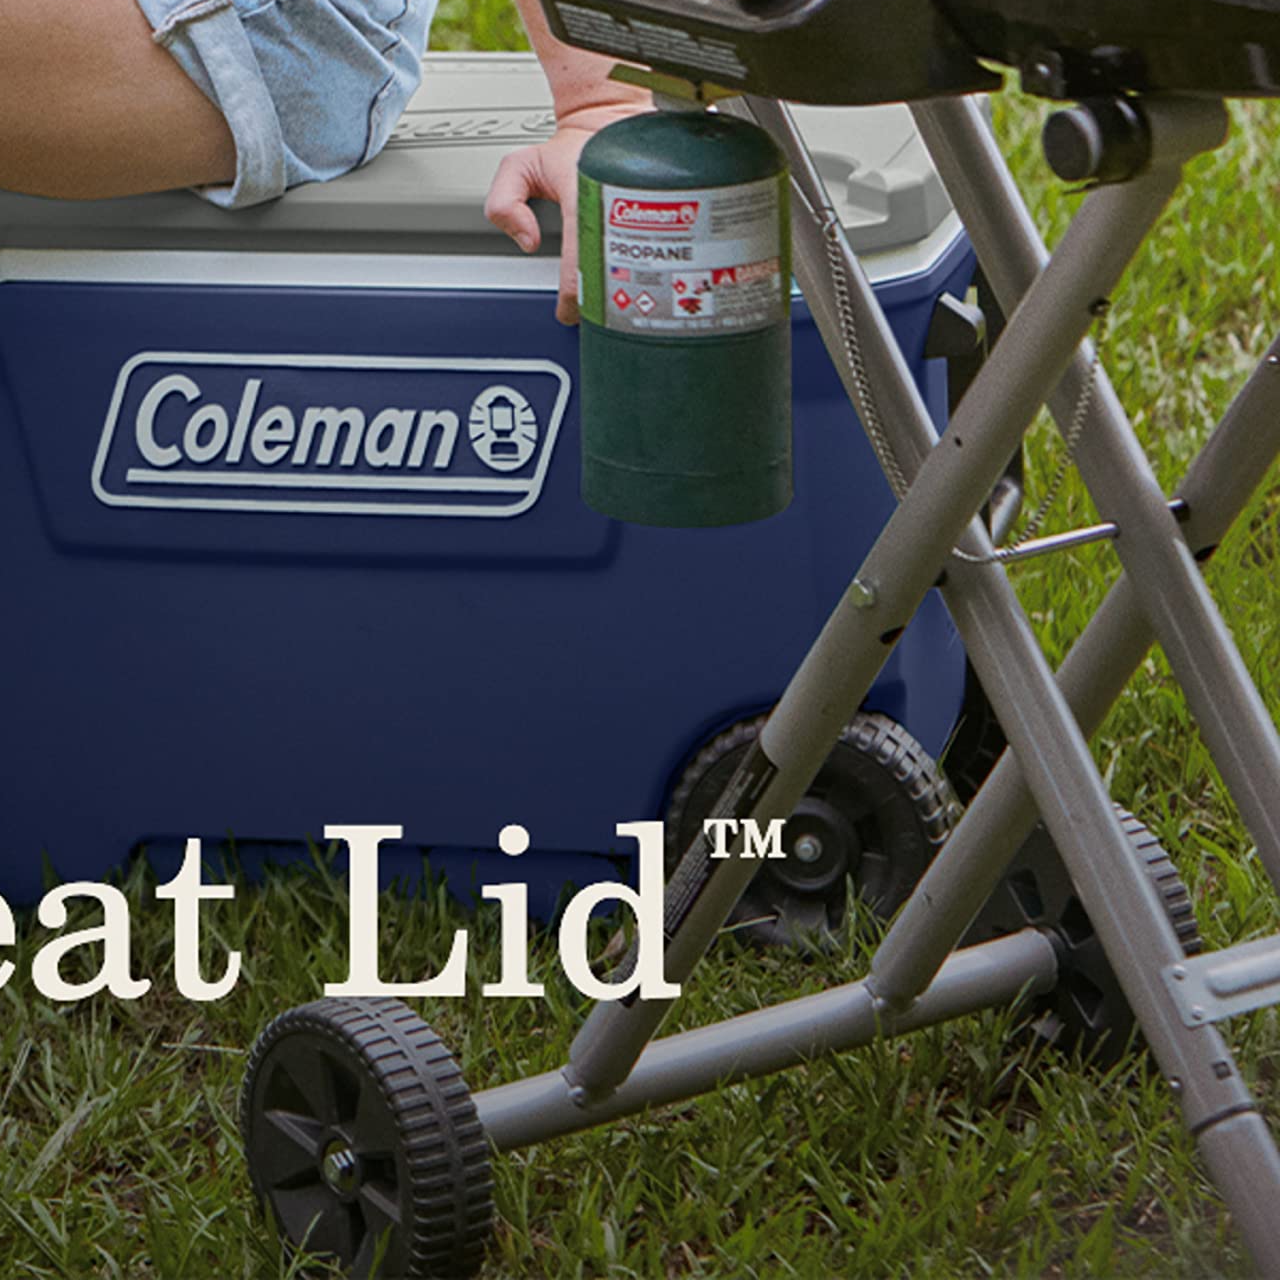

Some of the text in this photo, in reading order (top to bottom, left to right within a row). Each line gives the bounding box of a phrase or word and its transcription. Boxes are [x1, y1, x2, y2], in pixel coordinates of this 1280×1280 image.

[613, 200, 679, 223] Coleman
[609, 240, 694, 261] PROPANE
[135, 374, 460, 468] Coleman
